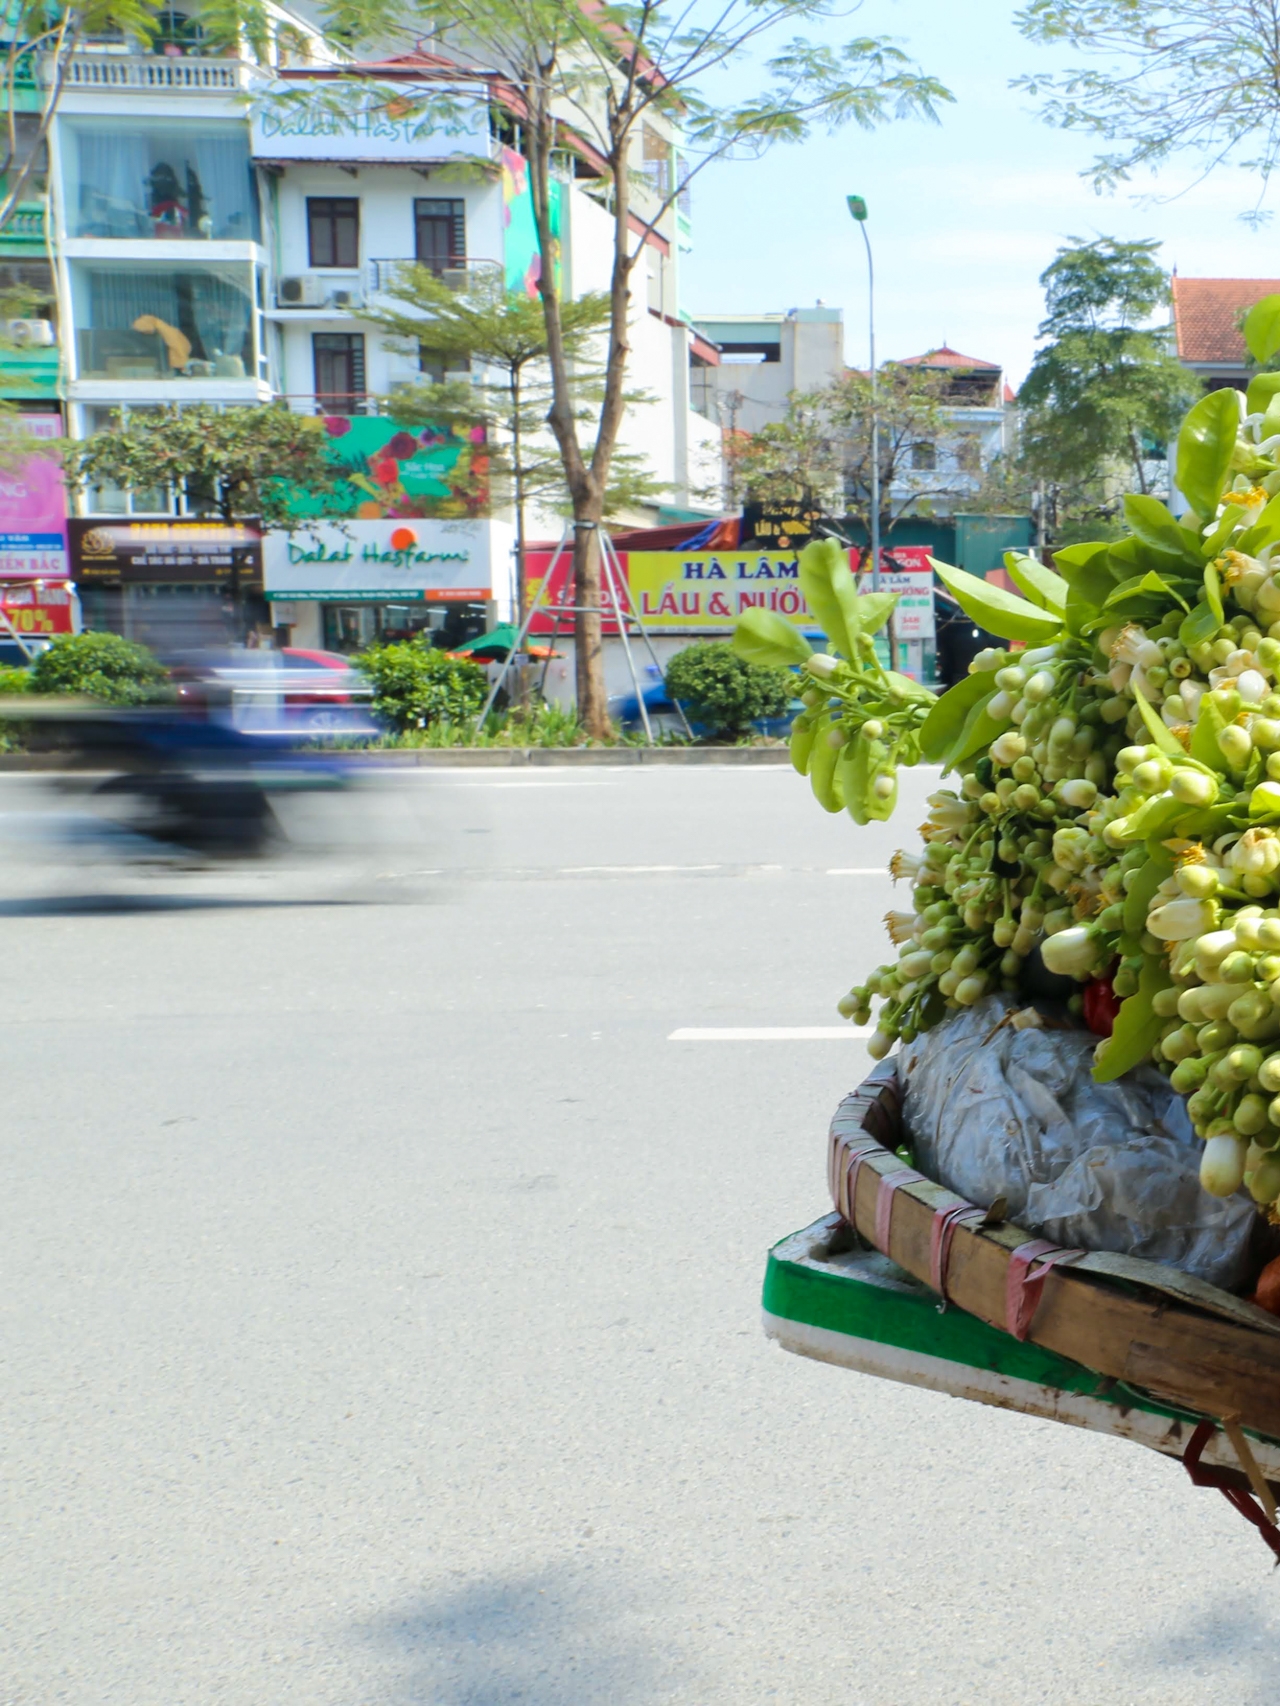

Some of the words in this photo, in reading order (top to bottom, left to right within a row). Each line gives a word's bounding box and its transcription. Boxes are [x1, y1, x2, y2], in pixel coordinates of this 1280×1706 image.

[286, 541, 354, 565] Dalat
[361, 541, 468, 569] Hasfarm
[683, 557, 727, 579] HÀ
[737, 556, 799, 579] LÂM
[708, 591, 731, 616] &
